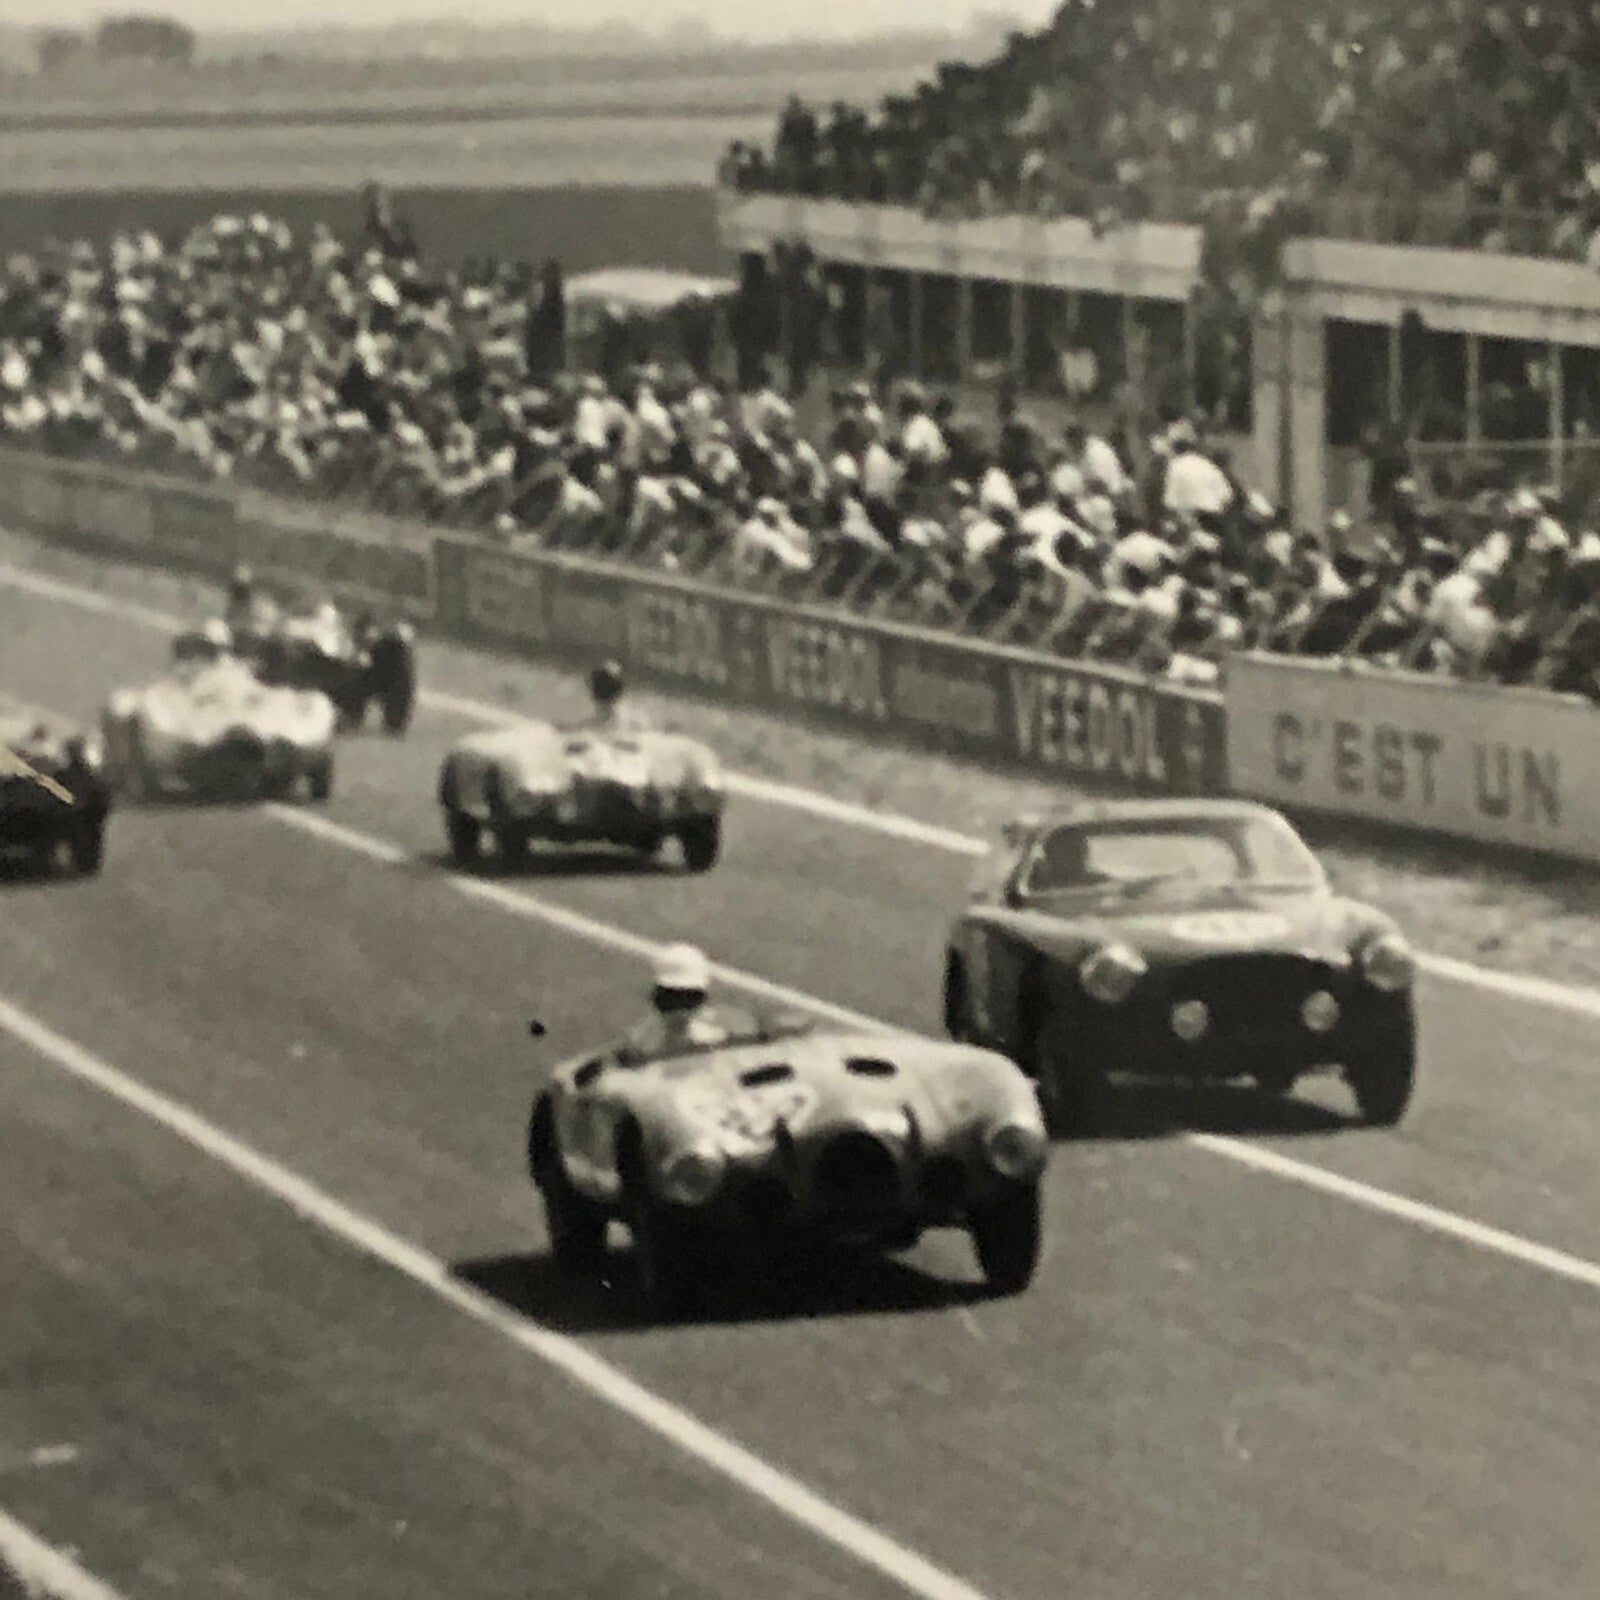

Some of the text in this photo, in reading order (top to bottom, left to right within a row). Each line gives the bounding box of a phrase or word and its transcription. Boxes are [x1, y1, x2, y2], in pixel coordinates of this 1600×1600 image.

[1010, 667, 1169, 784] VEEDOL
[1272, 711, 1445, 806] C'EST
[1473, 740, 1562, 828] UN
